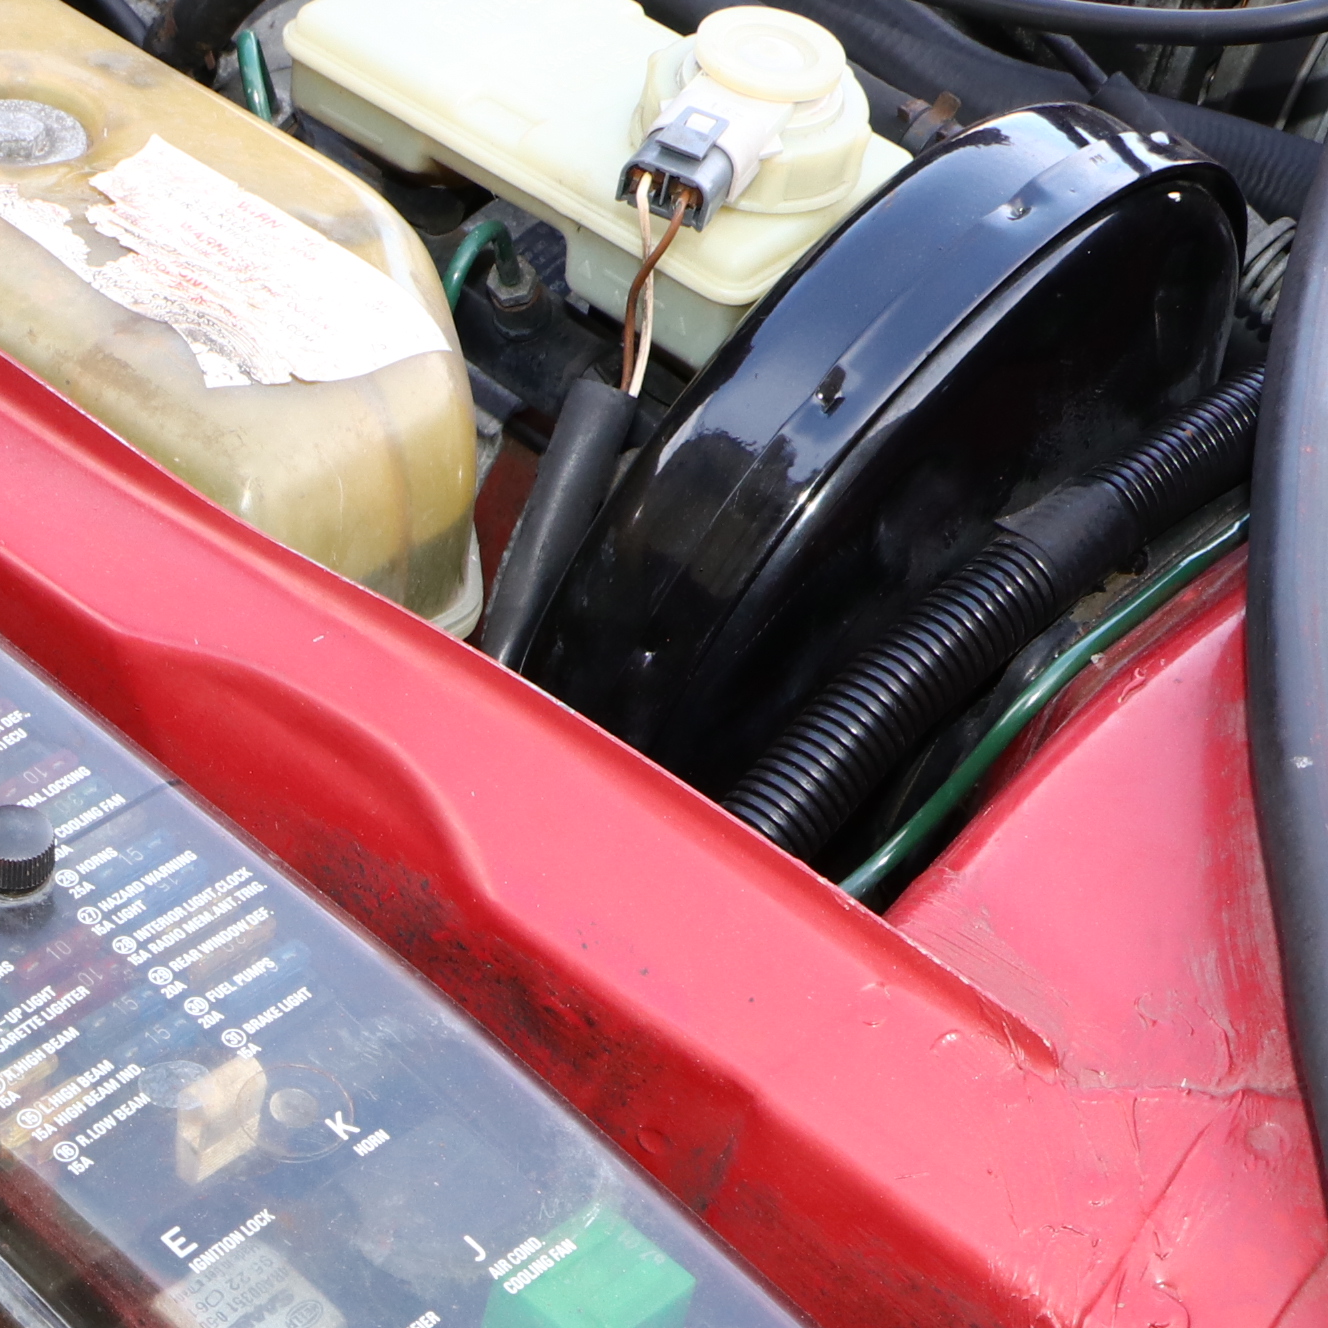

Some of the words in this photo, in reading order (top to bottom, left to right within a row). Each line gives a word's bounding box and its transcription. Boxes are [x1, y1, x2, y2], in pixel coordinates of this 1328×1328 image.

[2, 728, 27, 744] ECU
[41, 766, 91, 796] LOCKING
[54, 807, 103, 838] COOLING
[99, 793, 126, 811] FAN
[75, 847, 118, 874] HORNS
[68, 880, 95, 898] 25A
[98, 881, 146, 911] HAZARD
[141, 850, 197, 885] WARNING
[91, 919, 114, 936] 15A
[112, 900, 147, 923] LIGHT
[132, 906, 188, 940] INTERIOR
[127, 949, 151, 966] 15A
[148, 928, 186, 954] RADIO
[169, 949, 201, 971] REAR
[198, 920, 249, 954] WINDOW
[246, 905, 274, 925] DEF.
[161, 980, 187, 998] 20A
[206, 981, 237, 1002] FUEL
[233, 957, 275, 985] PUMPS
[20, 986, 58, 1011] LIGHT
[40, 985, 91, 1019] LIGHTER
[242, 1007, 282, 1034] BRAKE
[278, 987, 313, 1011] LIGHT
[198, 1010, 224, 1029] 20A
[1, 1049, 47, 1080] R.HIGH
[41, 1026, 80, 1053] BEAM
[237, 1042, 261, 1059] 15A
[31, 1122, 57, 1141] 15A
[52, 1101, 87, 1125] HIGH
[82, 1079, 121, 1105] BEAM
[115, 1061, 146, 1083] IND.
[37, 1082, 82, 1112] L.HIGH
[76, 1059, 115, 1087] BEAM
[75, 1116, 119, 1146] R.LOW
[112, 1093, 152, 1120] BEAM
[324, 1110, 361, 1141] K
[352, 1128, 390, 1156] HORN
[67, 1155, 94, 1175] 15A
[160, 1225, 199, 1259] E
[187, 1230, 246, 1273] IGNITION
[239, 1208, 275, 1236] LOCK
[463, 1234, 487, 1262] J
[486, 1258, 513, 1278] AIR
[506, 1234, 546, 1264] COND.
[501, 1254, 555, 1294] COOLING
[548, 1238, 577, 1260] FAN
